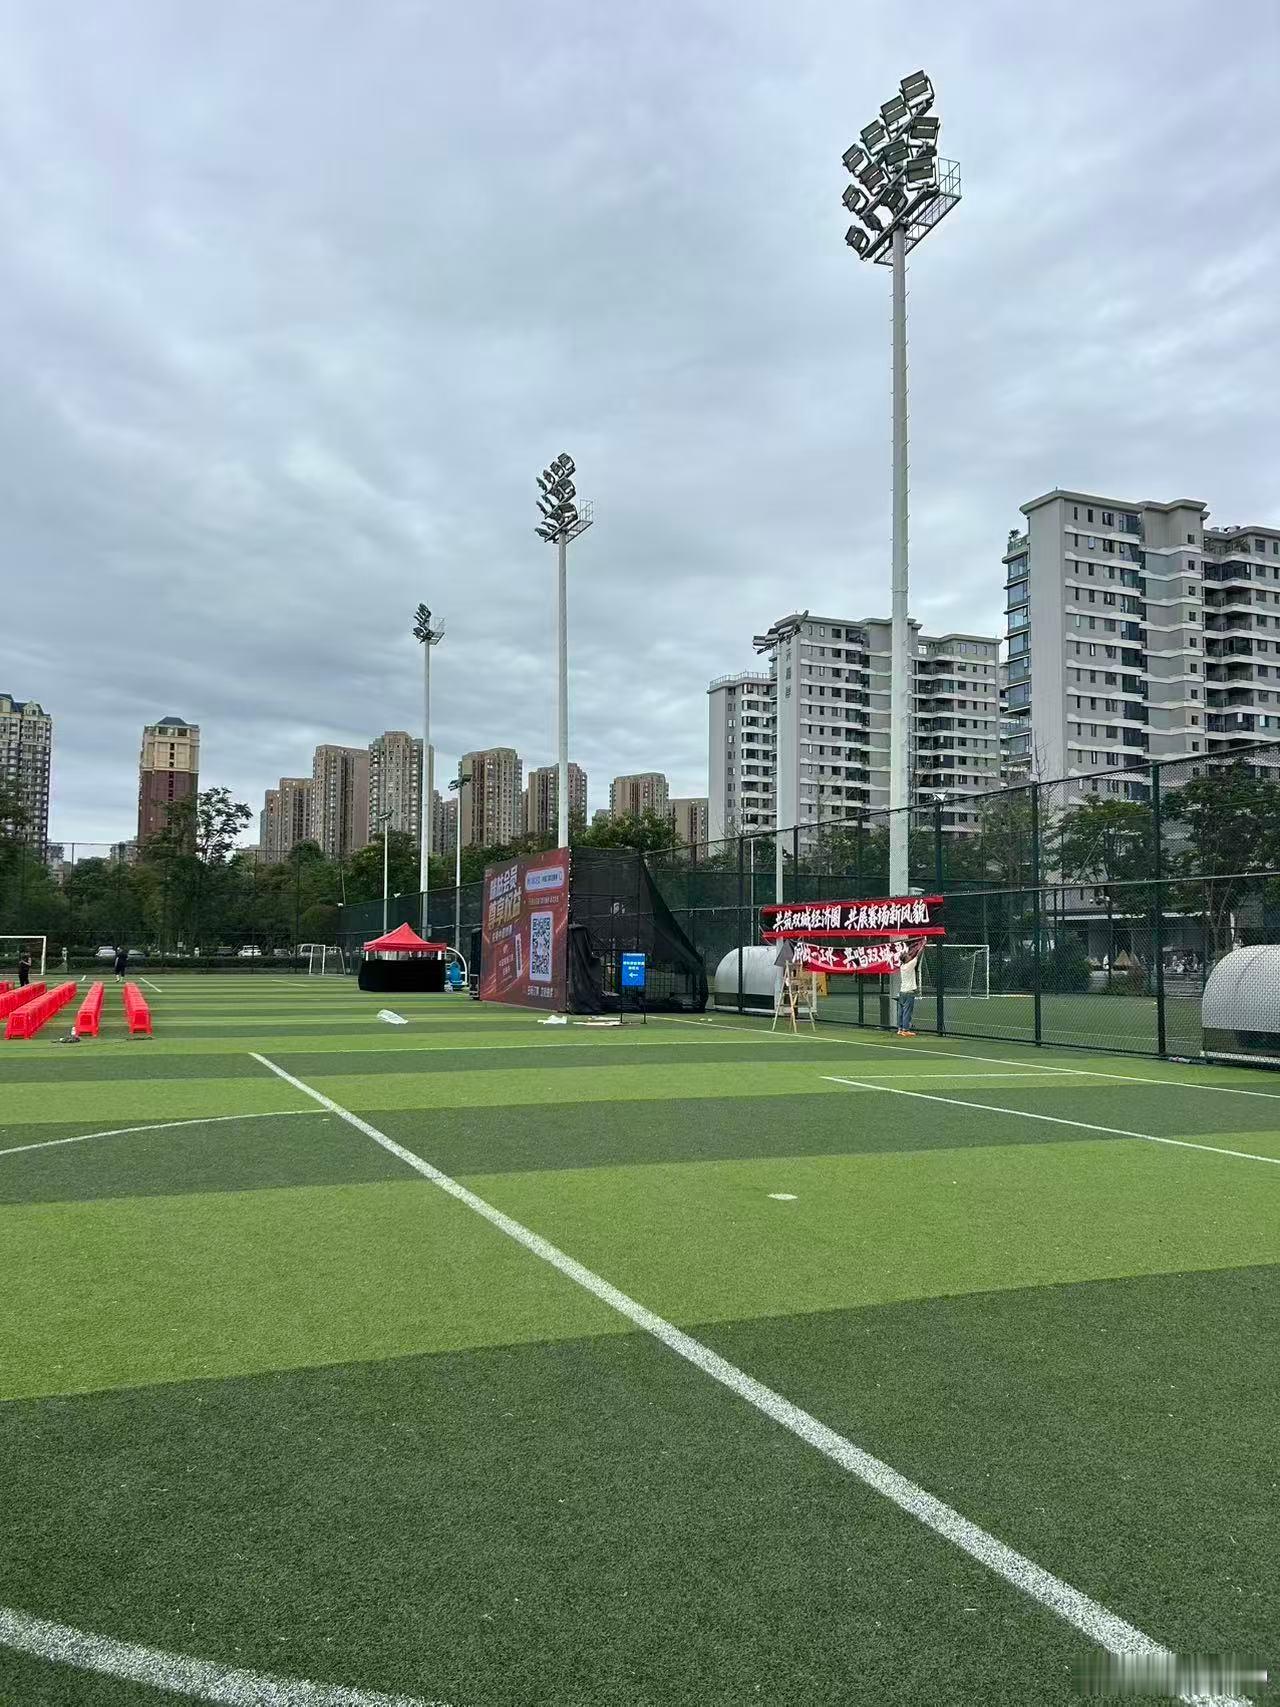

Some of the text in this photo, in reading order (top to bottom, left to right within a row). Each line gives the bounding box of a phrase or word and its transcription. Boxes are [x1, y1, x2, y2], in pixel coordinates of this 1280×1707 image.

[773, 899, 930, 932] 共筑双城经济圈 共展赛场新风貌
